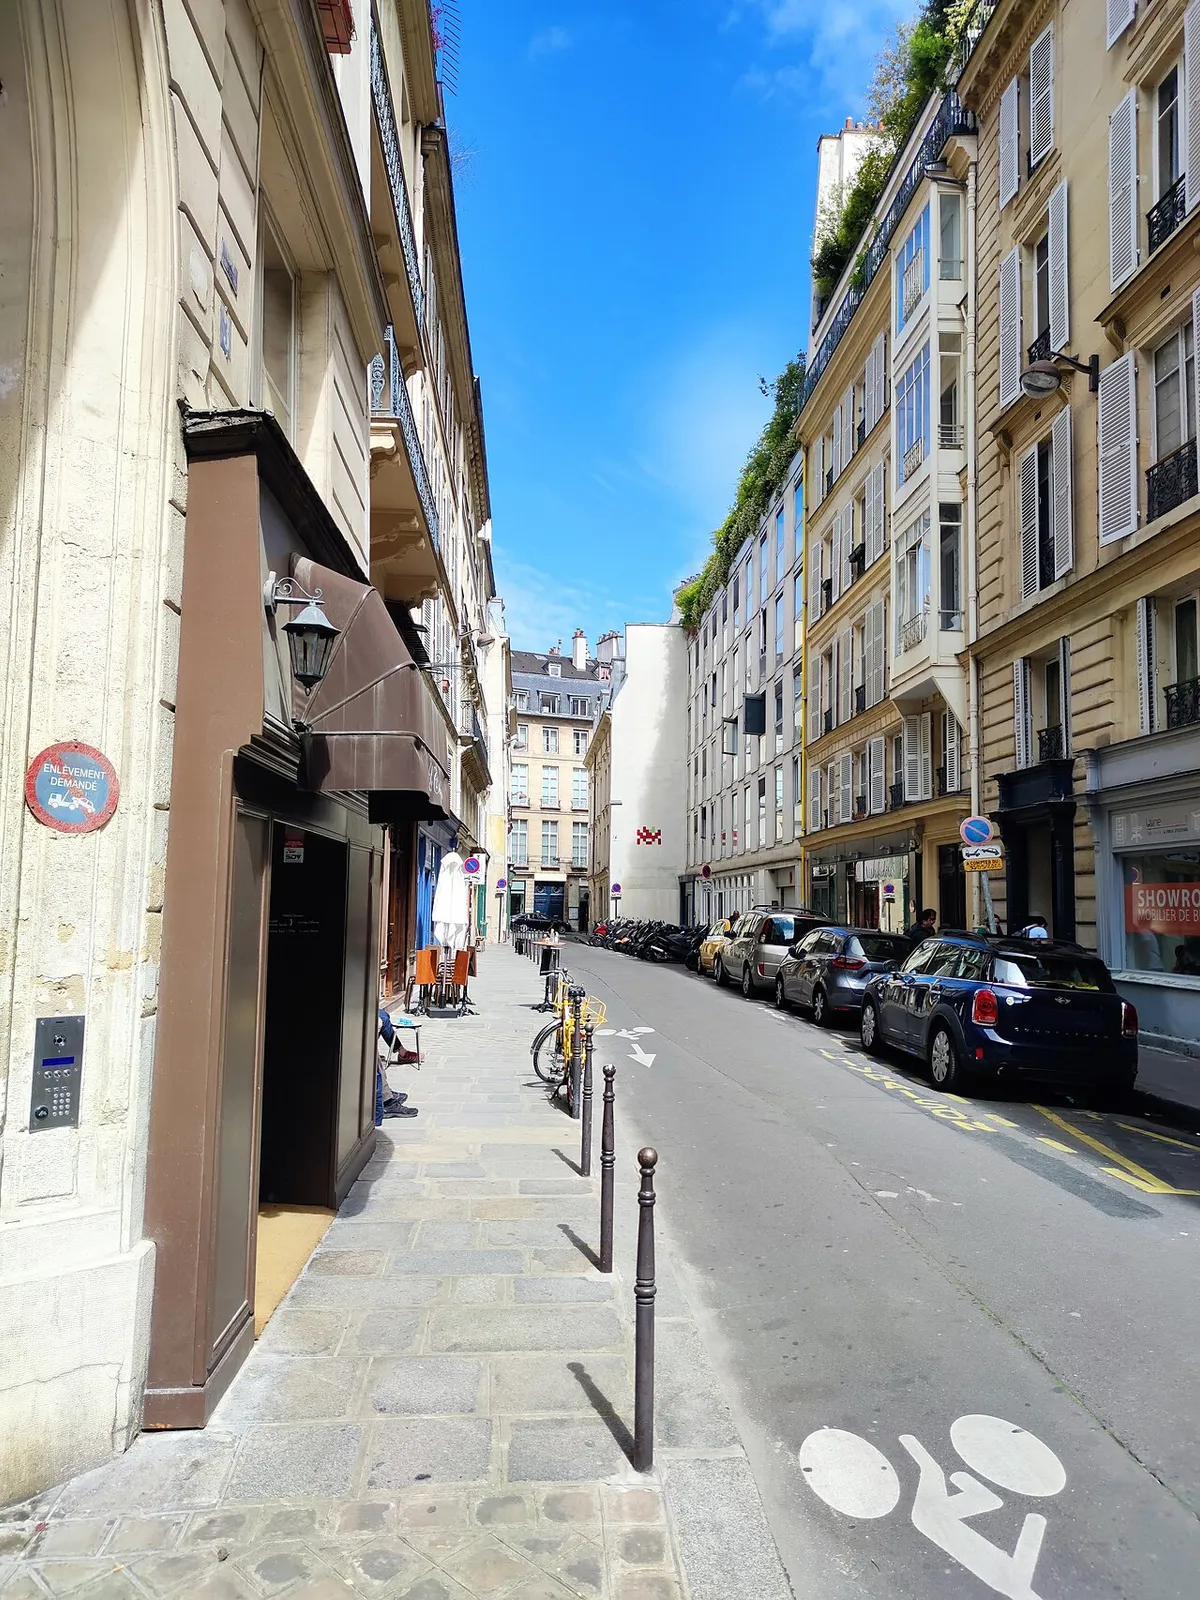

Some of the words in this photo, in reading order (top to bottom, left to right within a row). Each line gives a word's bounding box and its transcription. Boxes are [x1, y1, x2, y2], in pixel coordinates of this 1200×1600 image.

[43, 763, 106, 780] ENLÈVEMENT
[50, 777, 98, 791] DEMANDÉ
[1137, 889, 1200, 908] SHOWRO
[1138, 909, 1177, 921] MOBILIER
[1179, 909, 1191, 921] DE
